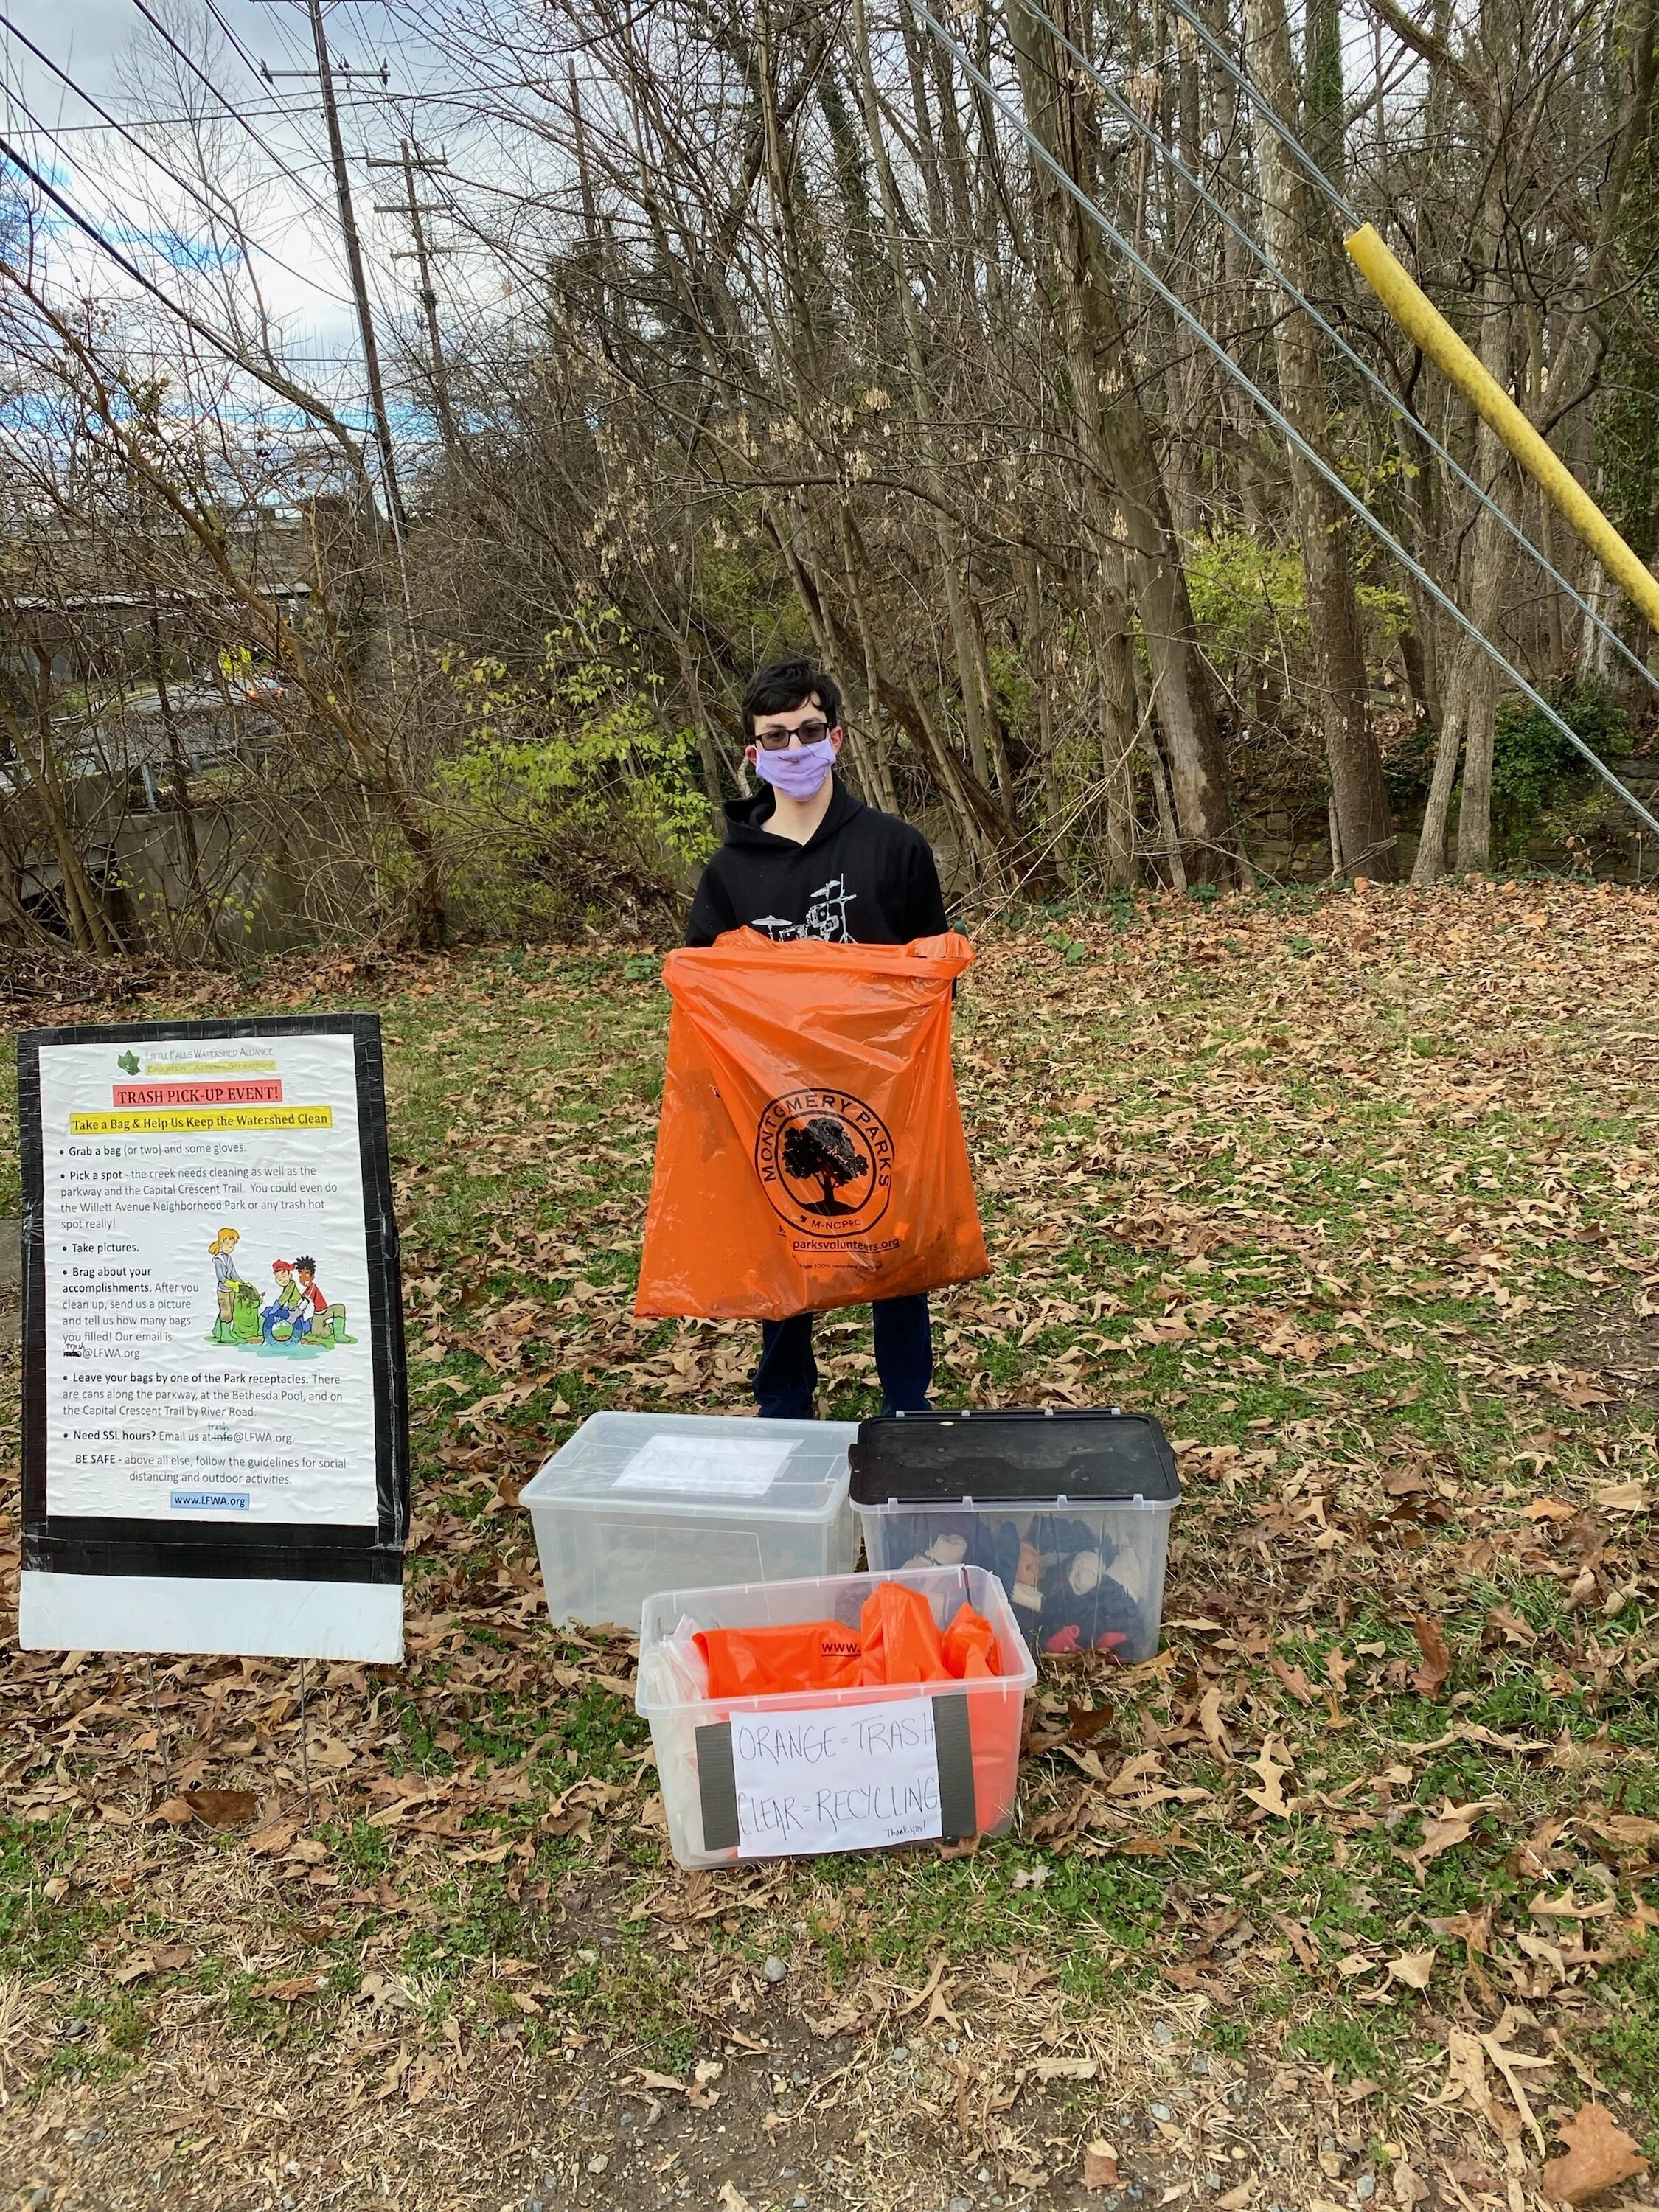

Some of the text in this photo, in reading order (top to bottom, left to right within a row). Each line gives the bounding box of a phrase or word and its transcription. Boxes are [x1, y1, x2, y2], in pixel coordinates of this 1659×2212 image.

[117, 1086, 277, 1104] TRASH PICK-UP EVENT!
[72, 1119, 98, 1130] Take
[110, 1119, 130, 1131] Bag
[131, 1118, 141, 1128] &
[142, 1117, 168, 1130] Help
[170, 1117, 184, 1127] Us
[185, 1116, 214, 1130] Keep
[216, 1115, 234, 1126] the
[235, 1113, 295, 1125] Watershed
[297, 1113, 328, 1124] Clean
[69, 1145, 91, 1156] Grab
[103, 1144, 121, 1157] bag
[123, 1144, 137, 1156] (or
[139, 1144, 161, 1155] two)
[164, 1144, 181, 1153] and
[185, 1145, 211, 1153] some
[213, 1142, 246, 1155] gloves.
[855, 1110, 892, 1187] PARKS
[69, 1169, 90, 1180] Pick
[92, 1172, 98, 1180] a
[100, 1170, 122, 1181] spot
[131, 1169, 147, 1178] the
[149, 1168, 175, 1178] creek
[178, 1166, 206, 1178] needs
[209, 1166, 248, 1179] cleaning
[264, 1166, 284, 1176] well
[299, 1164, 316, 1175] the
[60, 1182, 337, 1199] parkway and the Capital Crescent Trail. You could even do
[60, 1203, 77, 1213] the
[80, 1202, 112, 1212] Willett
[114, 1201, 150, 1211] Avenue
[153, 1200, 221, 1213] Neighborhood
[224, 1199, 245, 1209] Park
[261, 1201, 278, 1211] any
[280, 1199, 305, 1209] trash
[308, 1198, 324, 1209] hot
[60, 1217, 115, 1231] spot really!
[811, 1219, 861, 1230] M-NCPPC
[71, 1242, 139, 1253] Take pictures.
[793, 1238, 900, 1251] parksvolunteers.org
[72, 1266, 151, 1278] Brag about your
[62, 1281, 198, 1294] accomplishments. After you
[61, 1298, 88, 1309] clean
[91, 1301, 107, 1310] up,
[110, 1298, 133, 1308] send
[157, 1299, 192, 1310] picture
[62, 1315, 81, 1325] and
[84, 1315, 100, 1325] tell
[116, 1315, 137, 1325] how
[140, 1317, 166, 1326] many
[169, 1315, 191, 1327] bags
[63, 1331, 173, 1343] you filled! Our email is
[73, 1372, 339, 1385] Leave your bags by one of the Park receptacles. There
[62, 1388, 342, 1402] are cans along the parkway, at the Bethesda Pool, and on
[63, 1405, 257, 1418] the Capital Crescent Trail by River Road.
[207, 1422, 229, 1431] trash
[73, 1430, 100, 1439] Need
[102, 1430, 120, 1440] SSL
[122, 1430, 156, 1440] hours?
[159, 1430, 185, 1441] Email
[201, 1433, 211, 1441] at
[75, 1454, 88, 1464] BE
[90, 1454, 115, 1464] SAFE
[125, 1454, 154, 1465] above
[157, 1454, 167, 1464] all
[170, 1455, 192, 1467] else,
[195, 1455, 225, 1466] follow
[228, 1455, 245, 1466] the
[248, 1456, 299, 1469] guidelines
[302, 1456, 316, 1467] for
[319, 1458, 346, 1468] social
[129, 1470, 292, 1486] distancing and outdoor activities.
[174, 1495, 246, 1508] www.LFWA.org
[821, 1643, 860, 1652] www.
[739, 1725, 837, 1764] ORANGE
[851, 1710, 936, 1756] TRASH
[737, 1792, 804, 1841] CLEAR
[816, 1777, 939, 1833] RECYCLING
[884, 1820, 926, 1837] Thank you!
